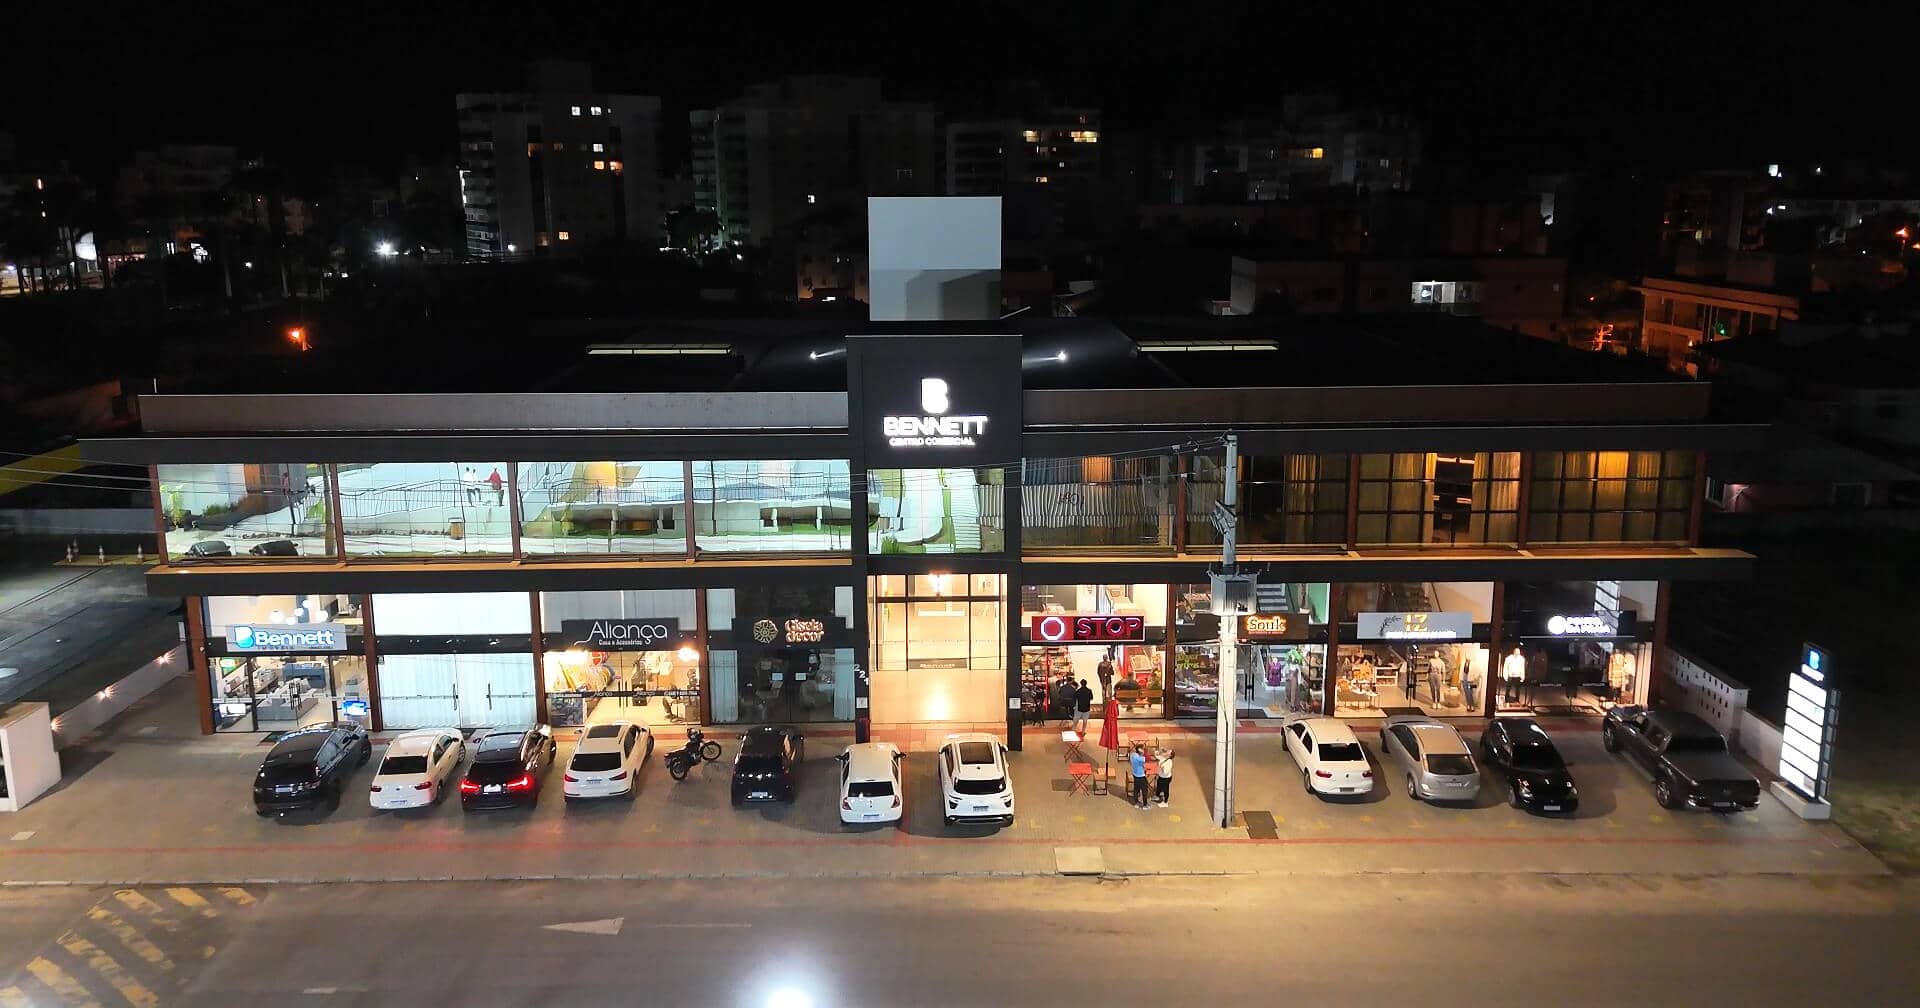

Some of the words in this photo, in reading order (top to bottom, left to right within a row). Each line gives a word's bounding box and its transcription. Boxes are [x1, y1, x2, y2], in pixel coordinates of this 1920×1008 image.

[883, 415, 988, 436] BENNETT
[785, 618, 823, 632] Gisela
[1076, 617, 1141, 638] STOP
[1247, 616, 1286, 632] Souk
[255, 630, 336, 646] Bennett
[576, 620, 668, 645] Aliança
[785, 631, 825, 642] decor
